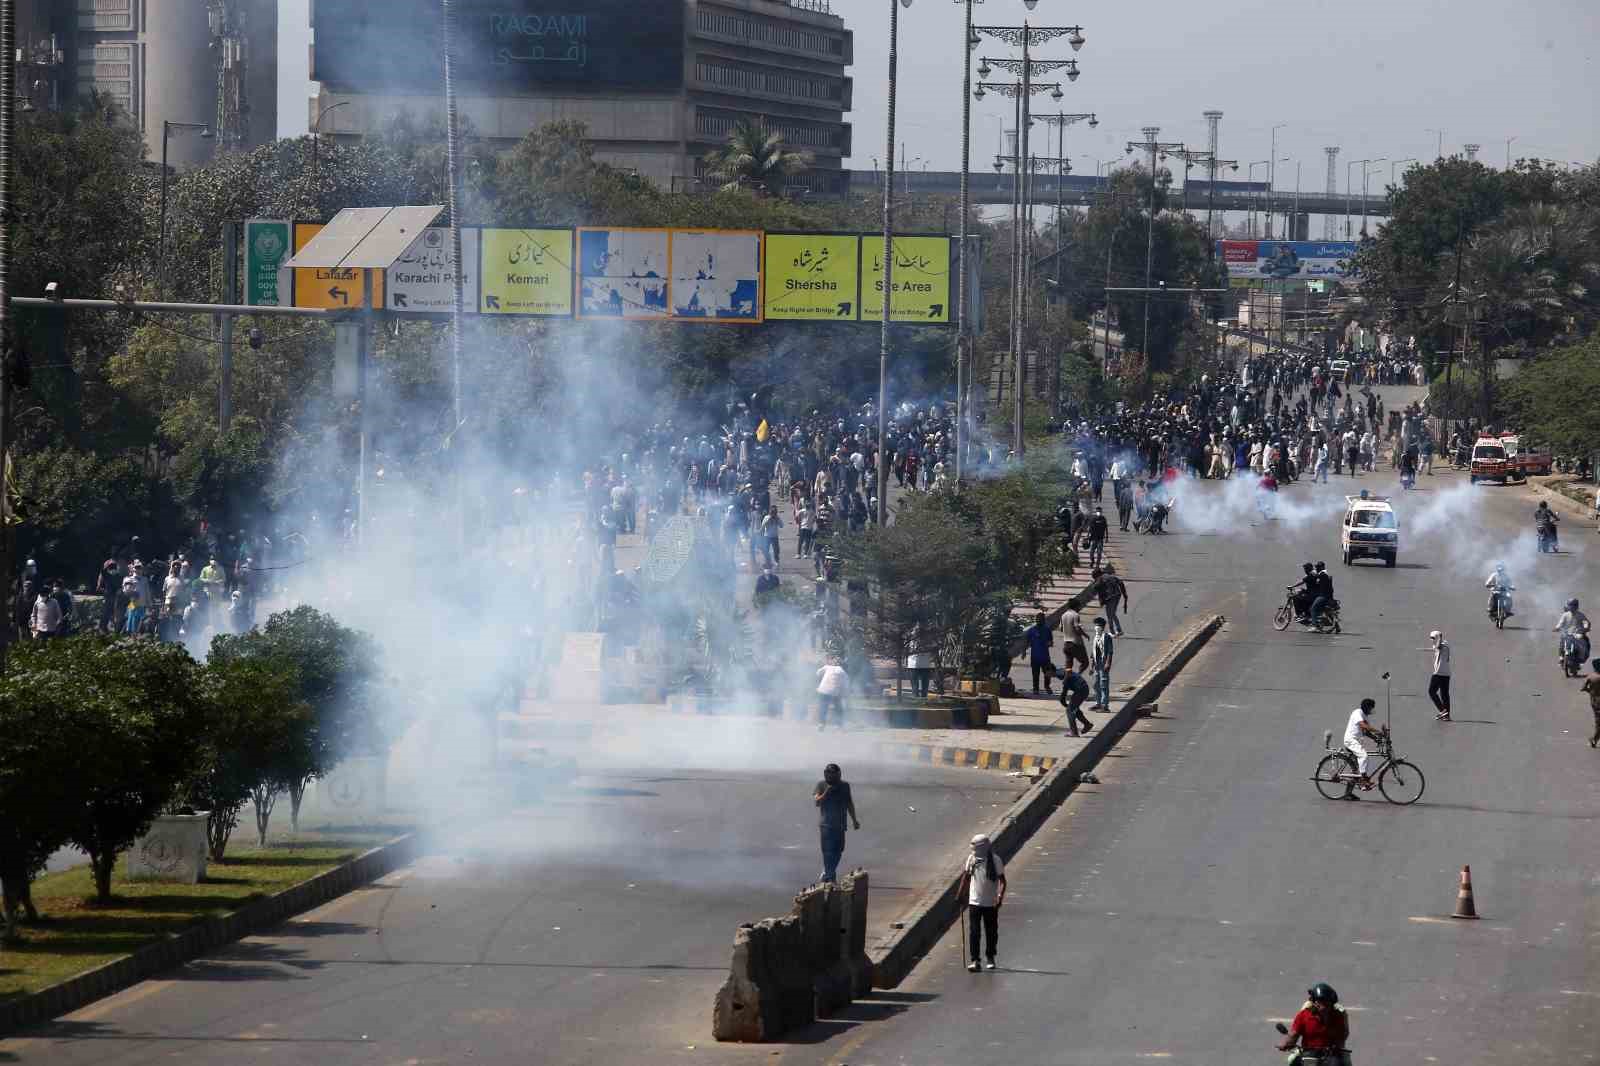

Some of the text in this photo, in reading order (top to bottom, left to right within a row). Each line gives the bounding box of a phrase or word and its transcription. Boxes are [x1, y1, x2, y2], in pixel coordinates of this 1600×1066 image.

[490, 15, 587, 35] RAQAMI
[395, 272, 440, 284] Karachi
[507, 273, 549, 285] Kemari
[785, 279, 837, 291] Shersha
[875, 280, 932, 292] Se Area
